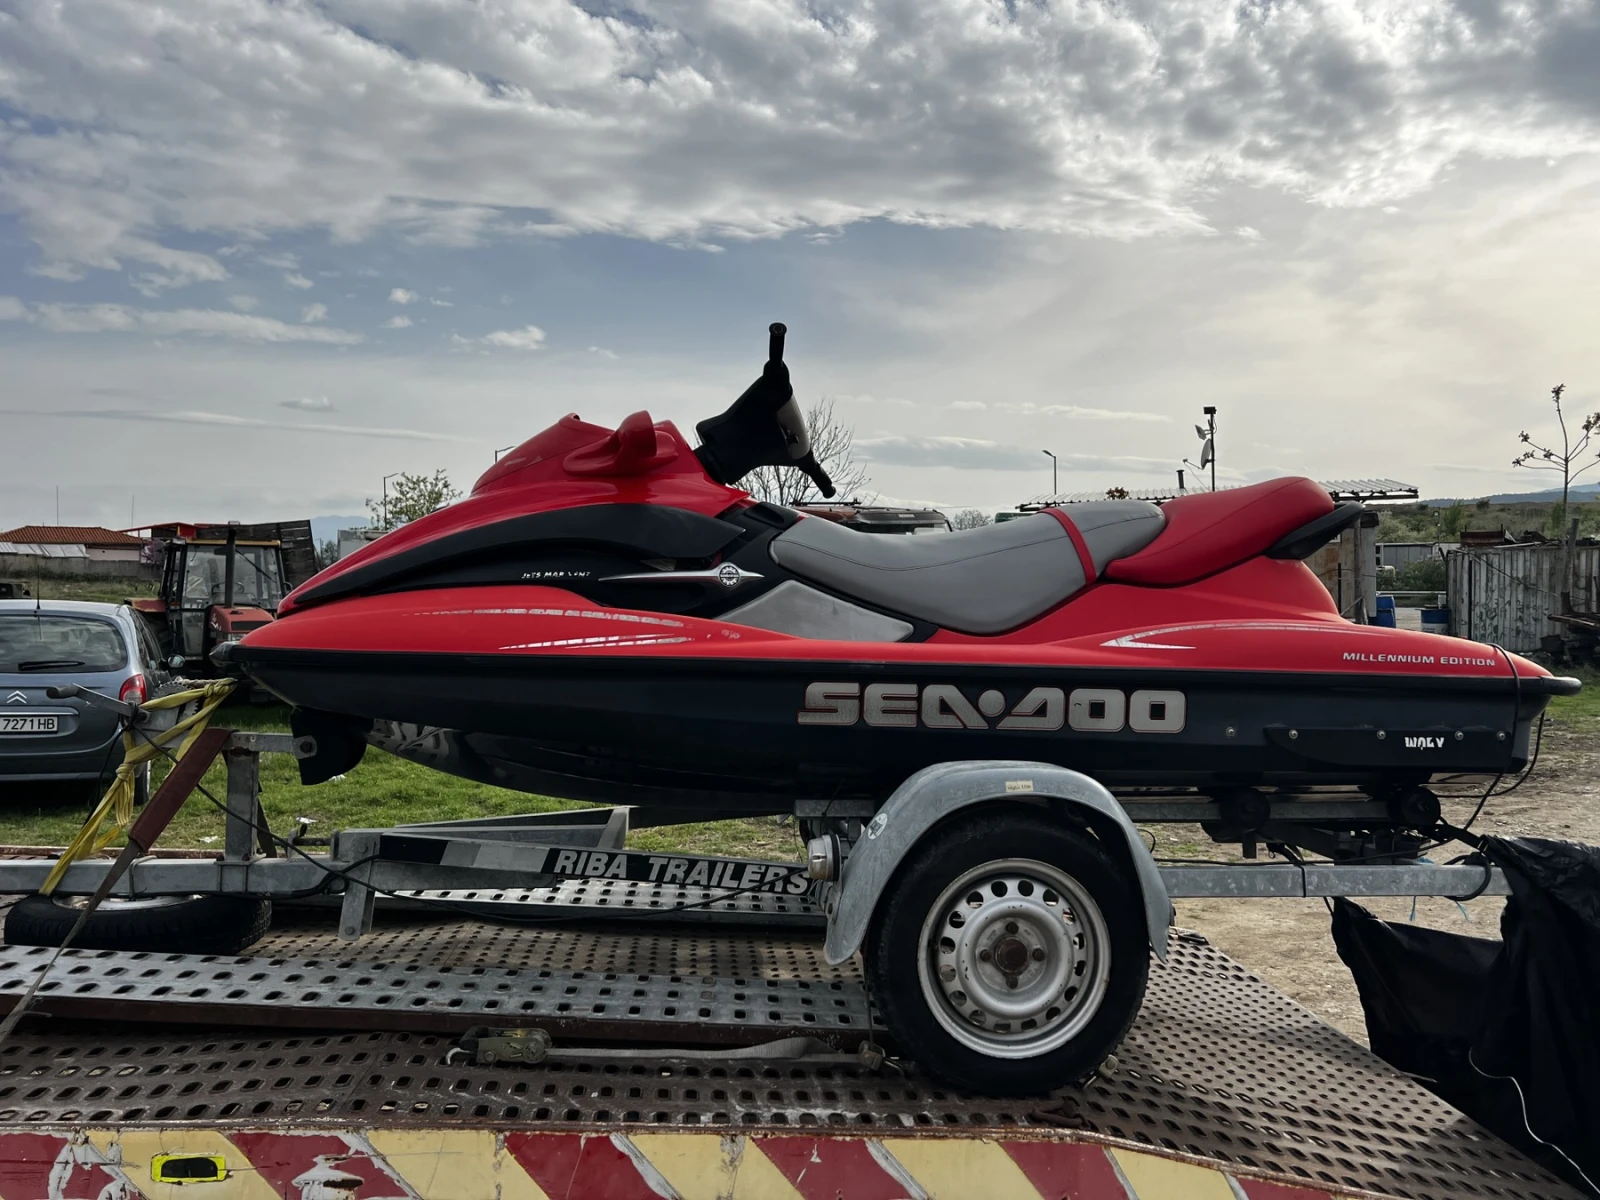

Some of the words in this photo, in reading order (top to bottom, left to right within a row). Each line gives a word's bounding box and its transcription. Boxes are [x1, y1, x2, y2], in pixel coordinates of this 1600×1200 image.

[1343, 652, 1434, 664] MILLENNIUM
[1440, 656, 1496, 666] EDITION
[3, 718, 34, 730] 7271
[554, 850, 627, 879] RIBA
[648, 857, 810, 895] TRAILERS
